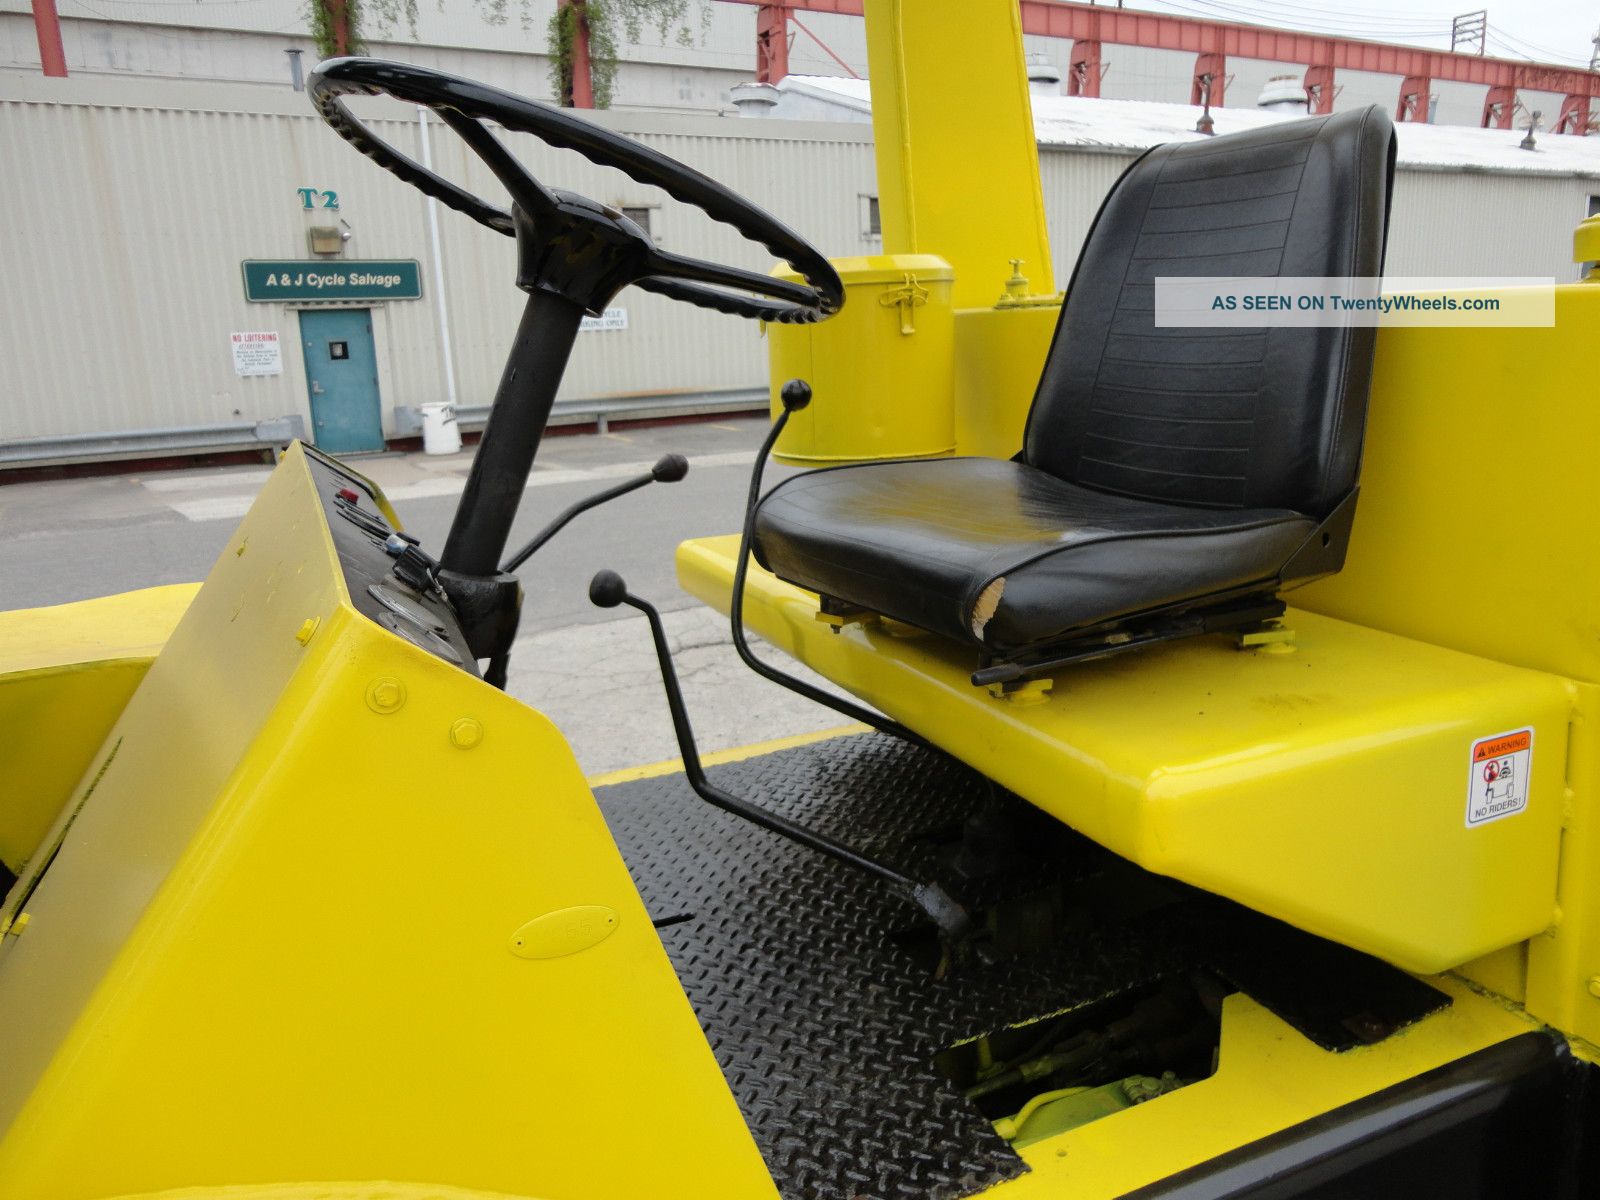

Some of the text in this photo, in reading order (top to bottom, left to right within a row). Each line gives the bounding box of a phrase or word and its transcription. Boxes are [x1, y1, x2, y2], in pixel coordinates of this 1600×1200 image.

[266, 272, 401, 289] A & J Cycle Salvage
[232, 333, 278, 343] NO LOITERING
[1487, 738, 1526, 754] WARNING
[1475, 798, 1521, 818] NO RIDERS!
